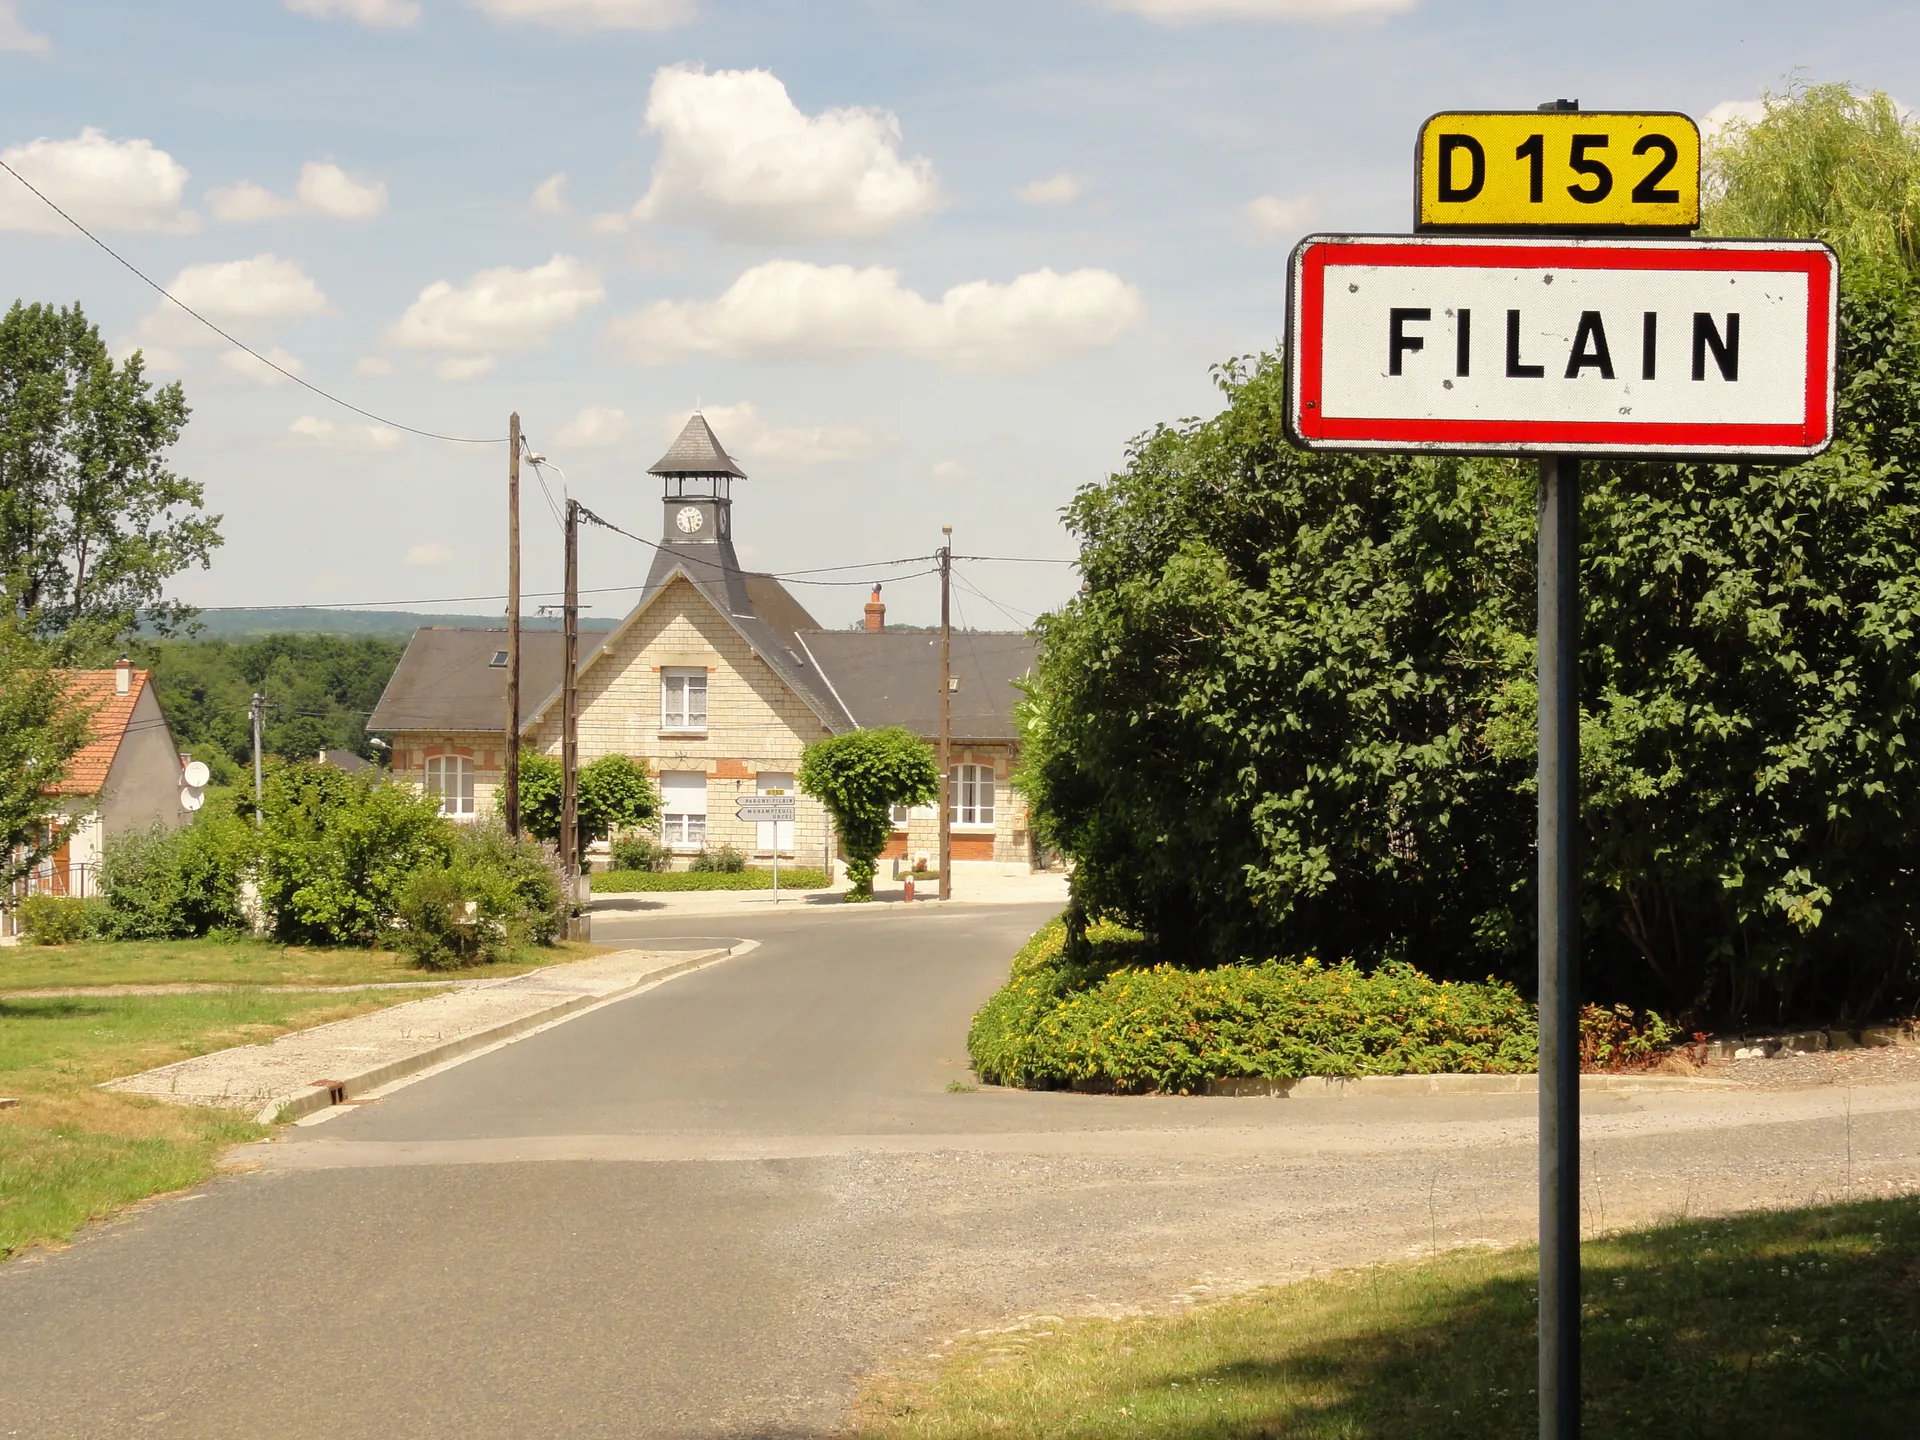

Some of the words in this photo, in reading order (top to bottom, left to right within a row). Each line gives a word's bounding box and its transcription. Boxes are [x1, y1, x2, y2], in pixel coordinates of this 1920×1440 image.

[1438, 134, 1485, 203] D
[1516, 134, 1679, 204] 152
[1389, 308, 1740, 382] FILAIN
